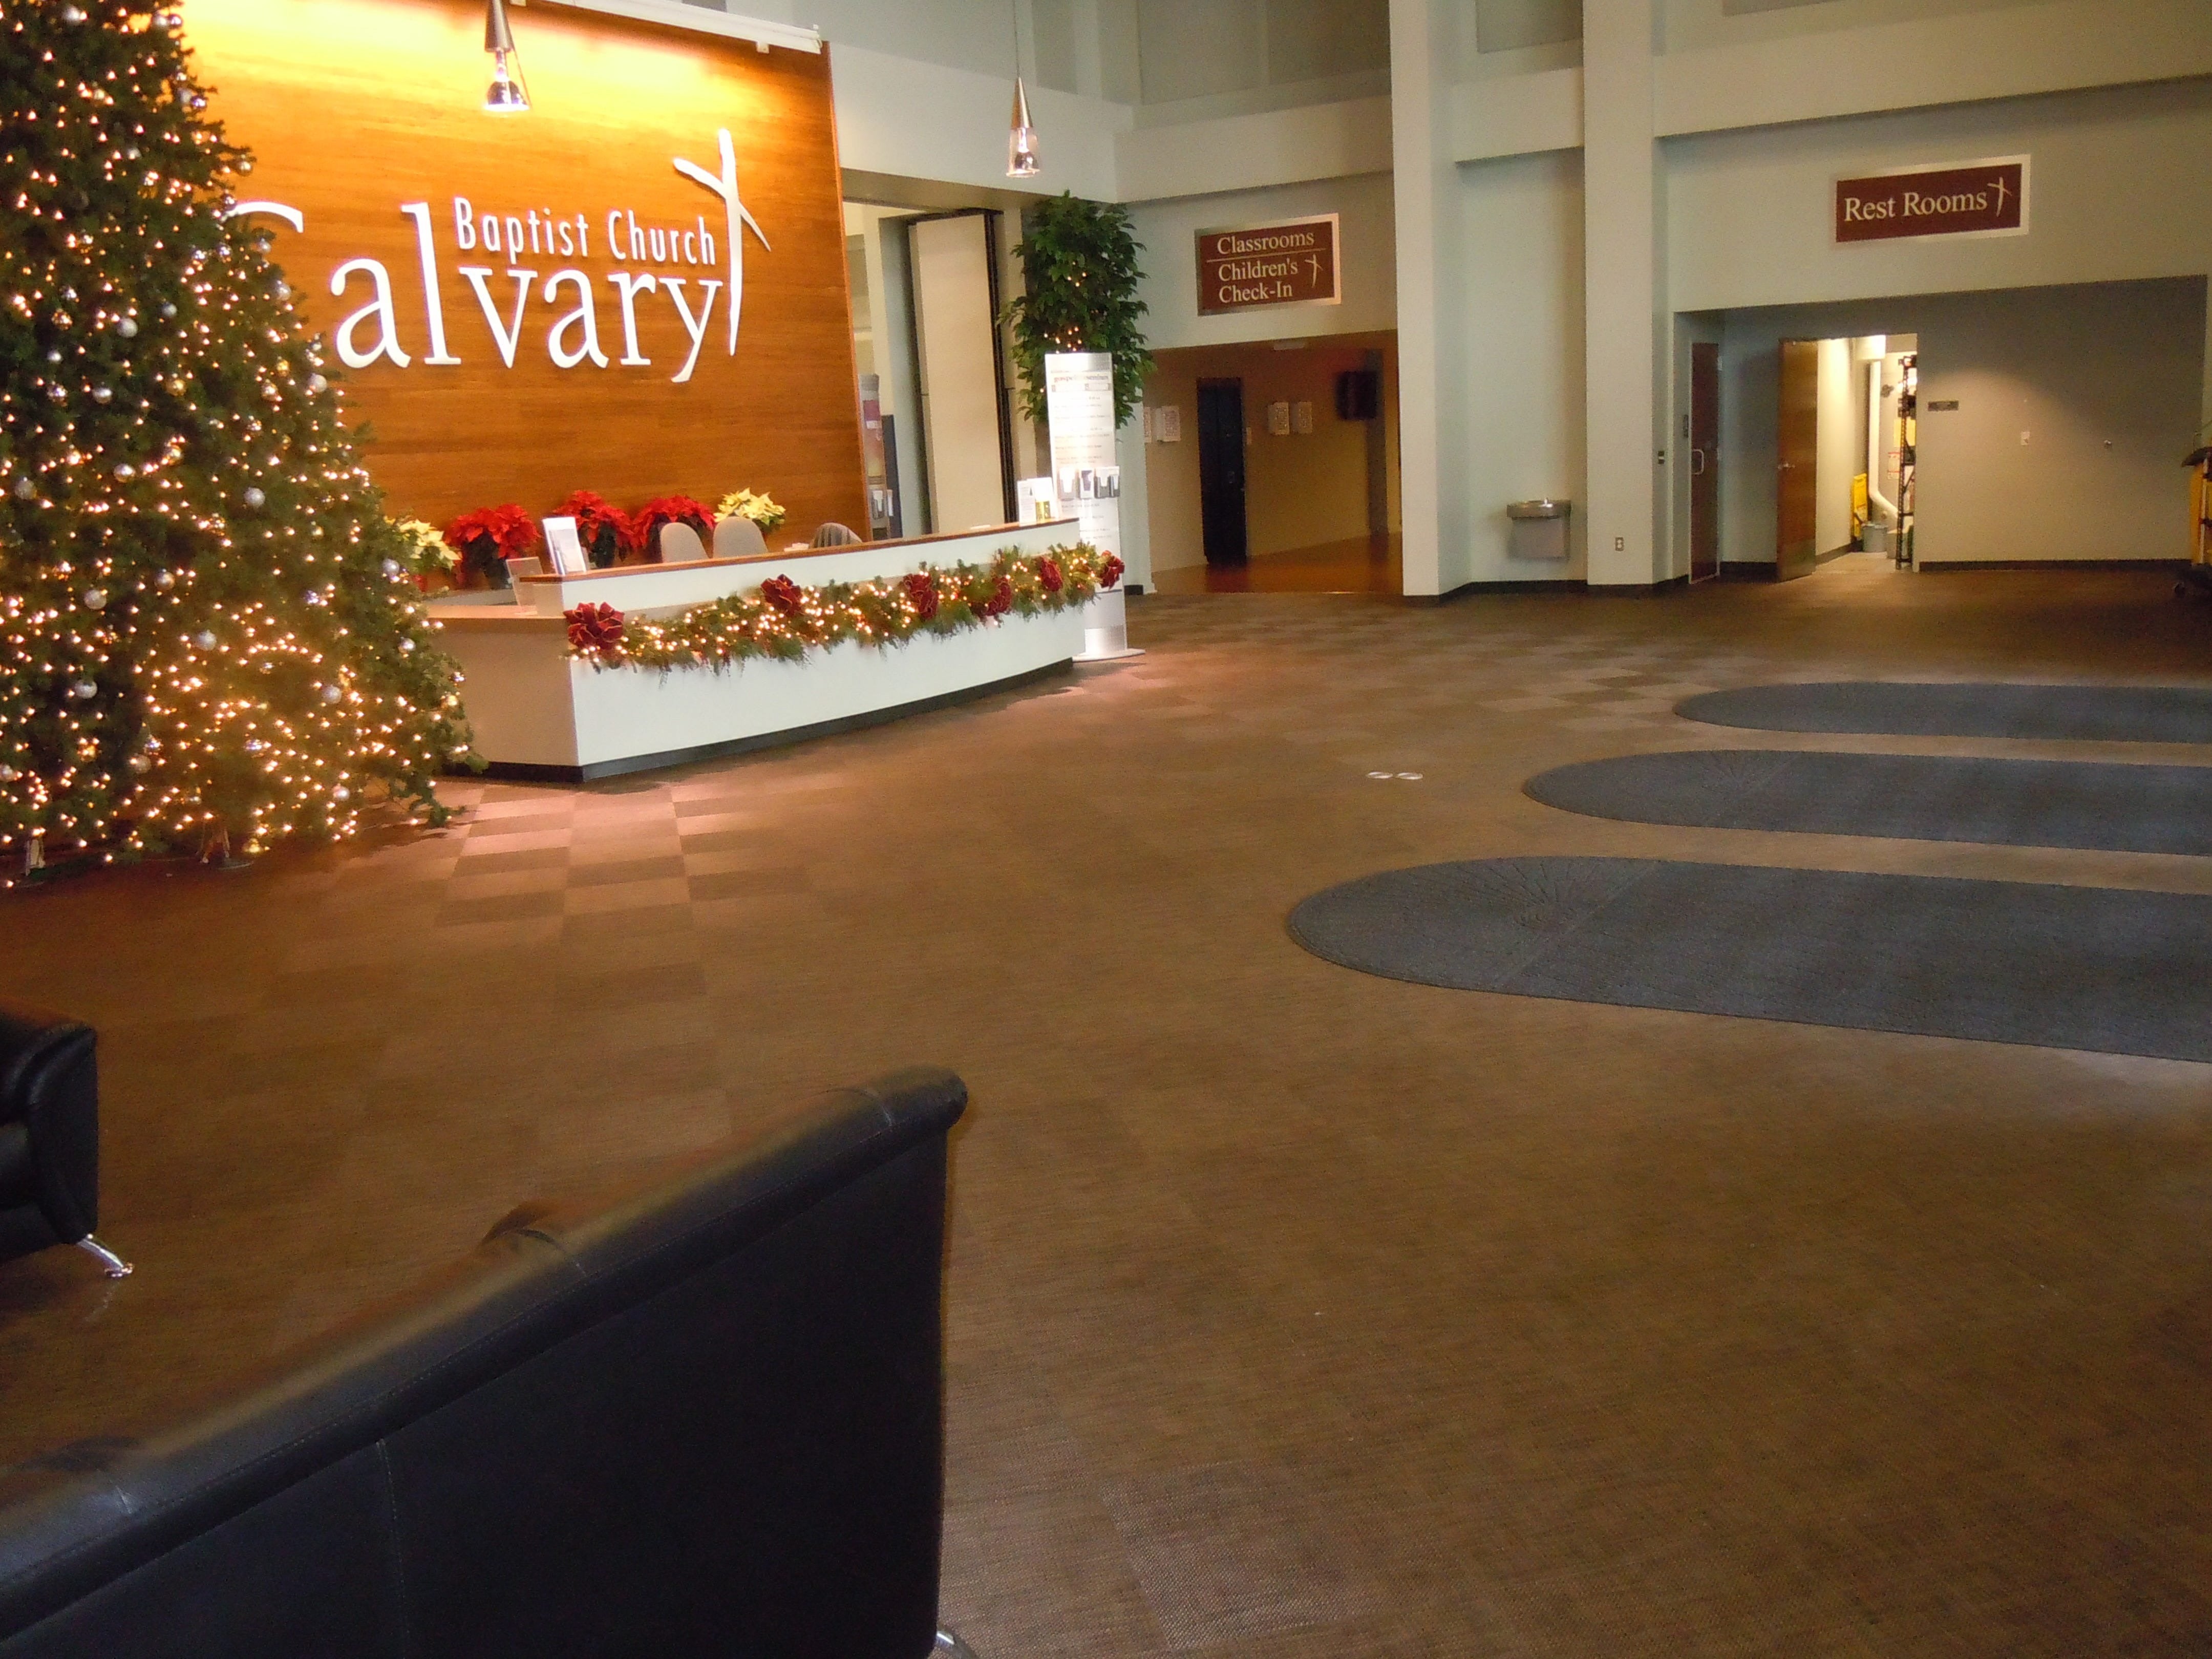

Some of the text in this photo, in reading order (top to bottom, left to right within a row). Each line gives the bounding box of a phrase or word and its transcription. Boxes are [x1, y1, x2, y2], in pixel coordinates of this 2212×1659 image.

[1843, 191, 1988, 222] Rest Rooms
[454, 196, 716, 266] Baptist Church
[1217, 231, 1315, 255] Classrooms
[1218, 258, 1299, 282] Children's
[225, 200, 724, 383] alvary
[1219, 281, 1293, 304] Check-In
